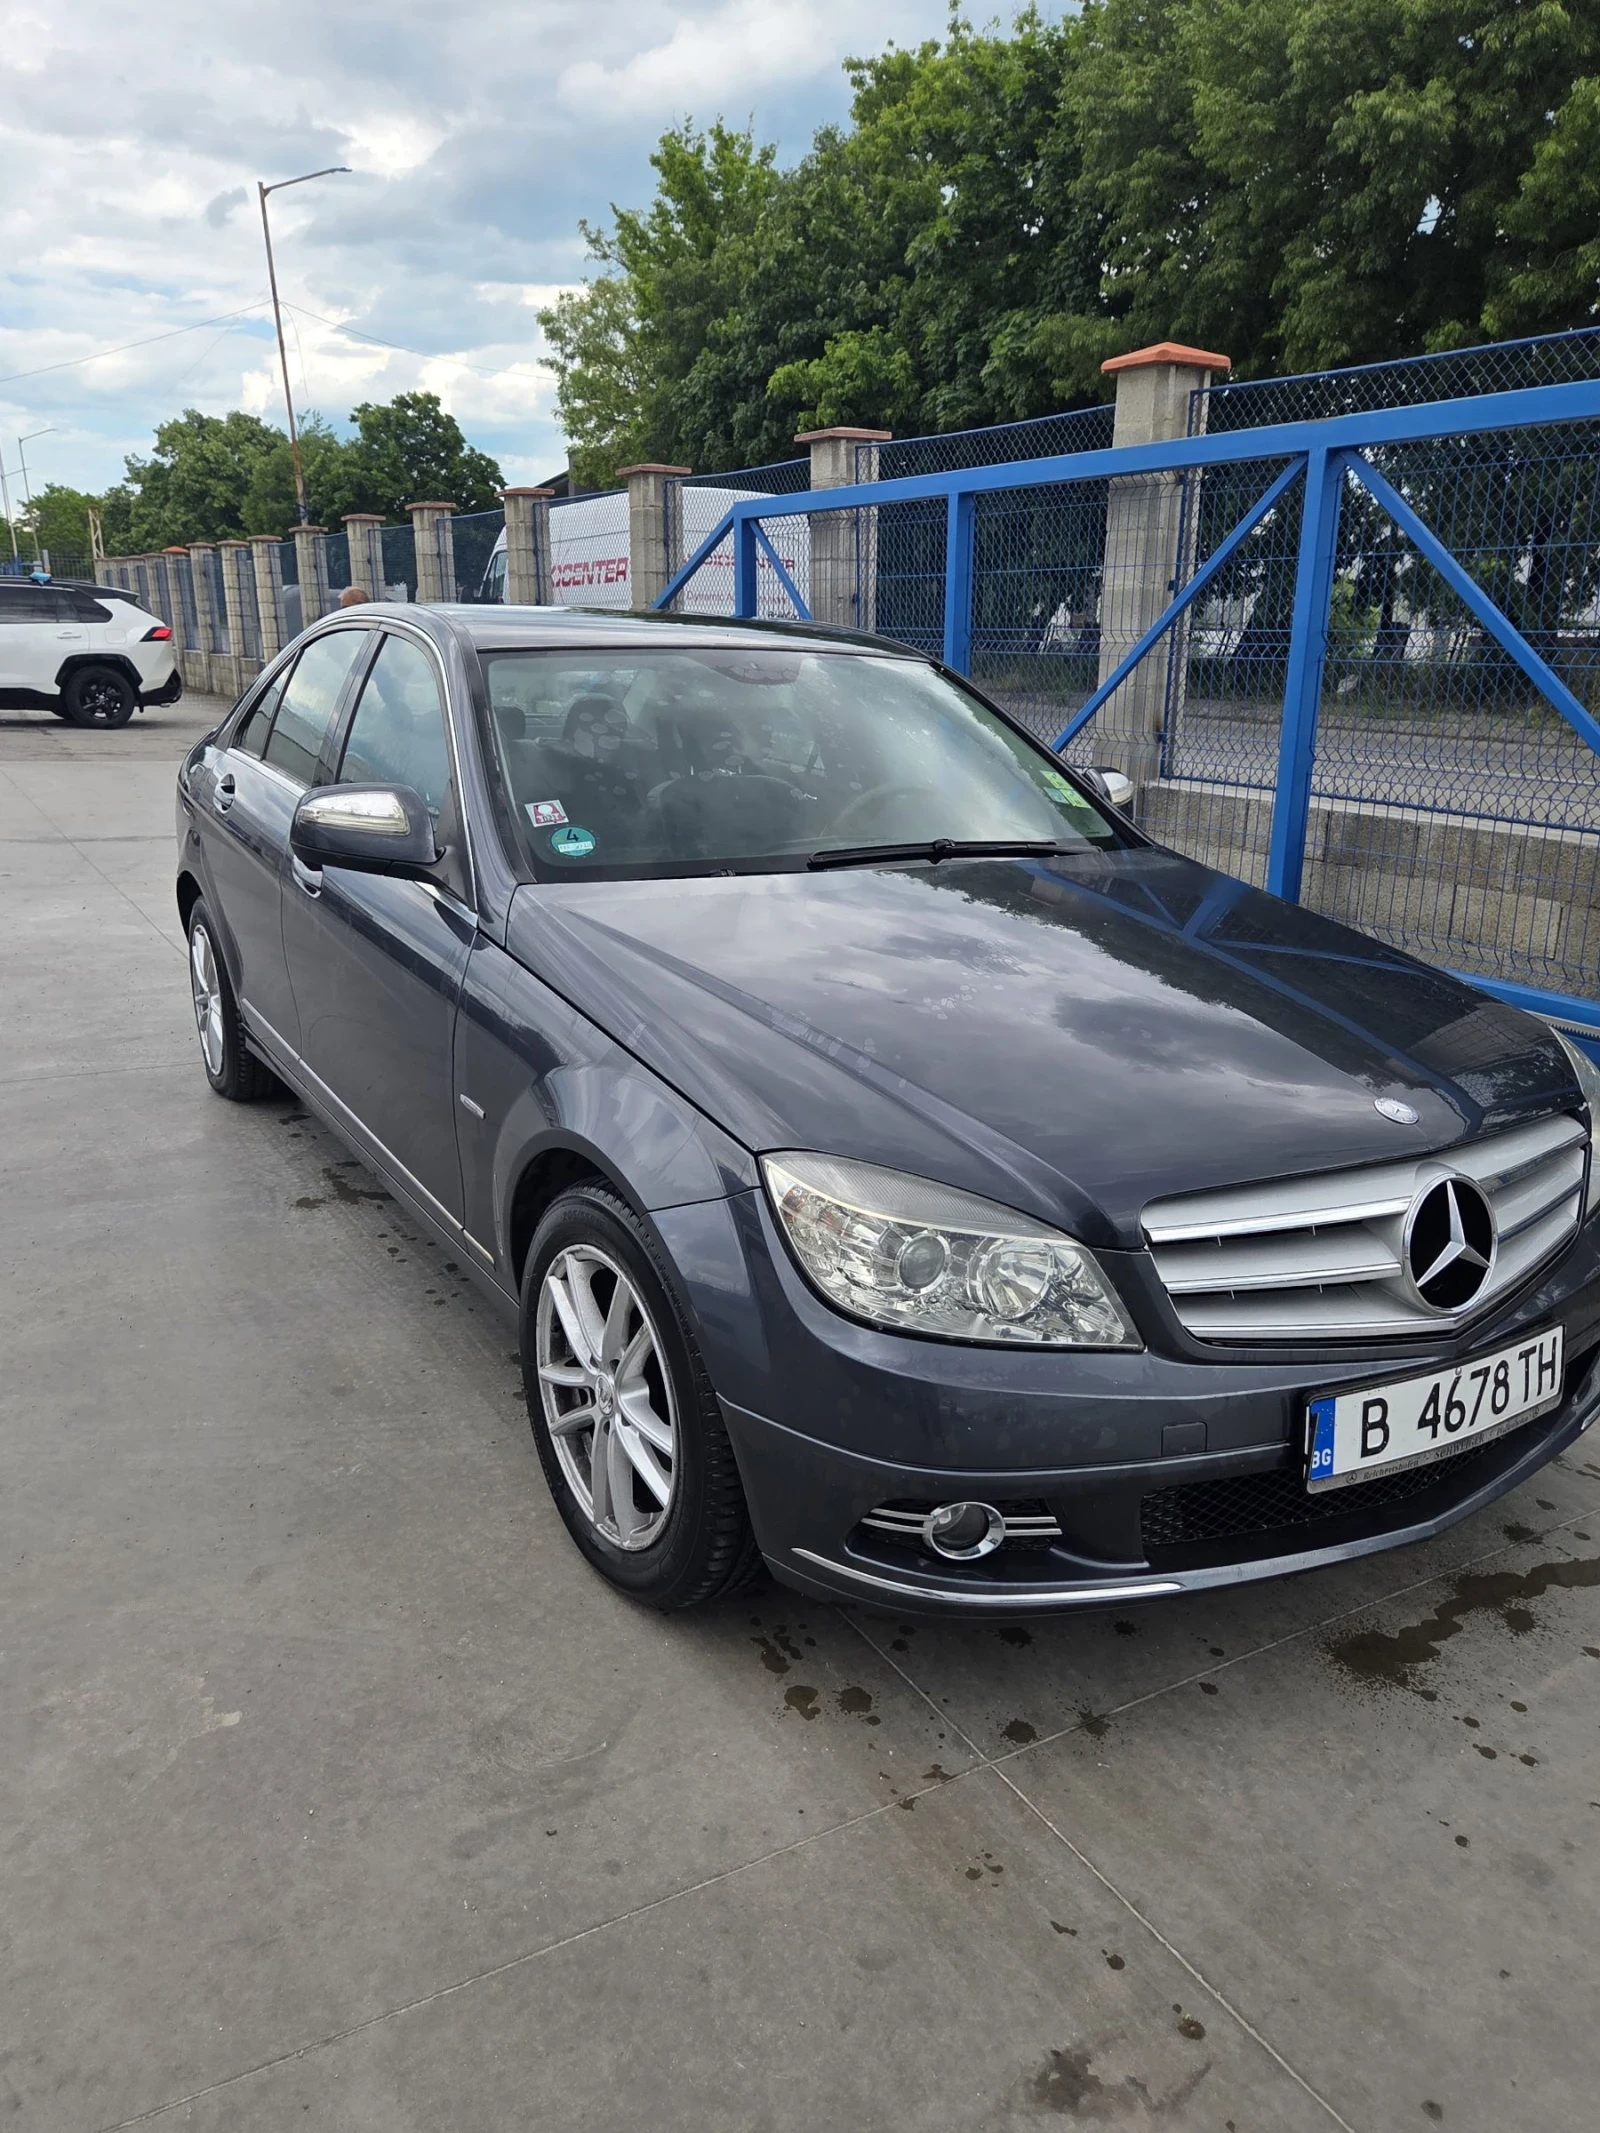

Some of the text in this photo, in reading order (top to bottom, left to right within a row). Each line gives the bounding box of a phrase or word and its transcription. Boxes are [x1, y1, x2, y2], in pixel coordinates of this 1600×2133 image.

[567, 829, 579, 841] 4
[1361, 1336, 1557, 1458] B 4678 TH
[1311, 1448, 1332, 1469] BG
